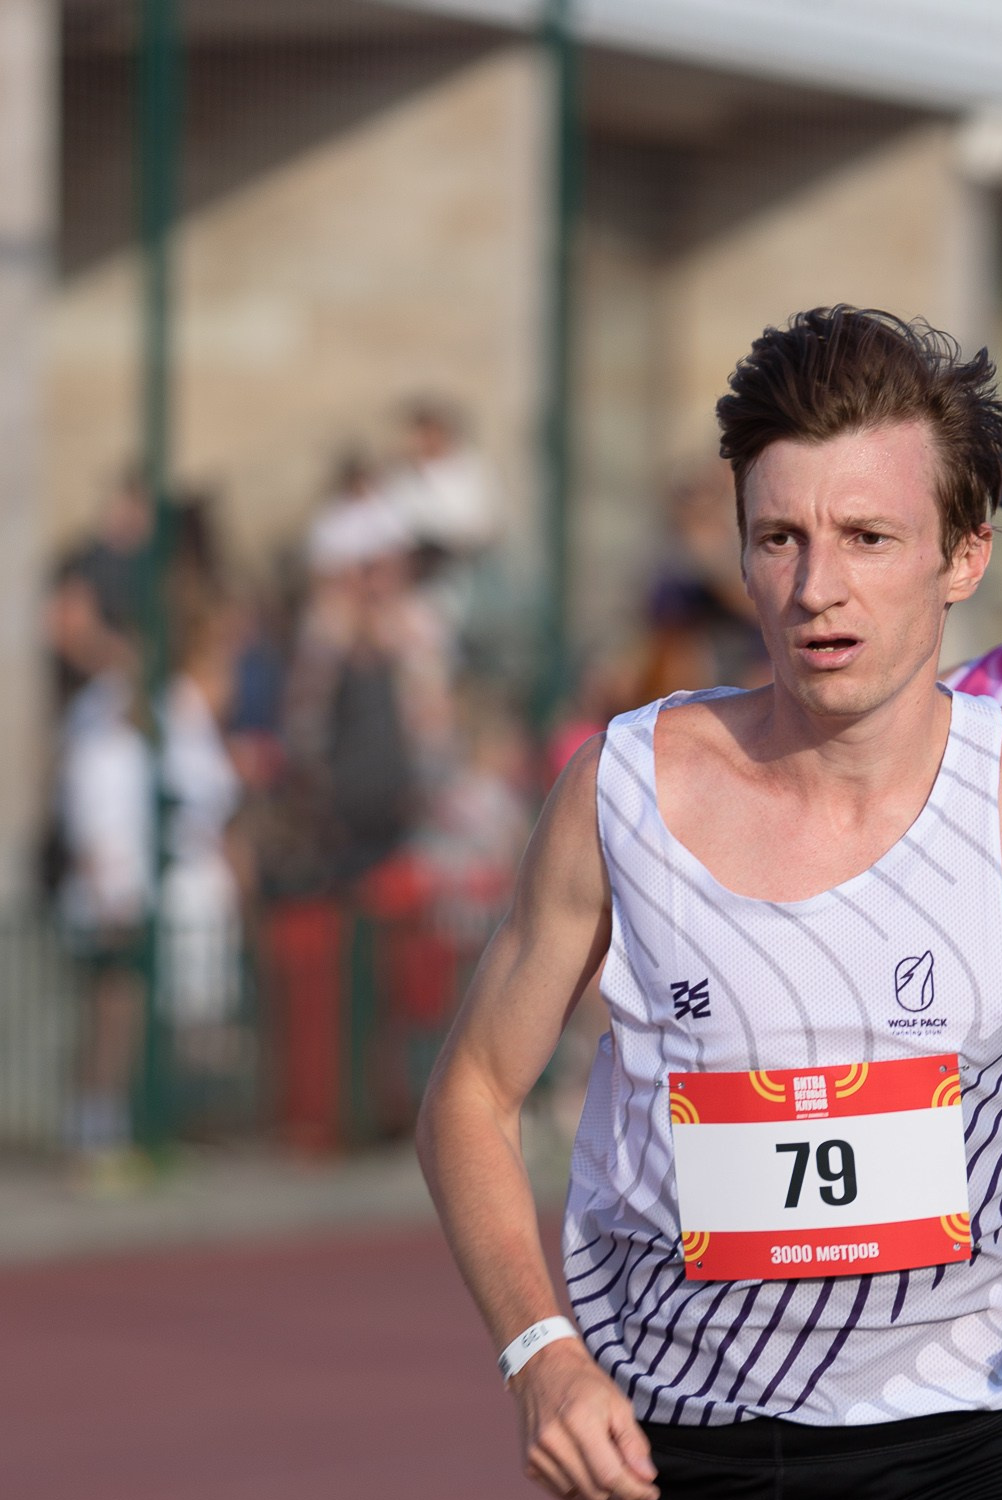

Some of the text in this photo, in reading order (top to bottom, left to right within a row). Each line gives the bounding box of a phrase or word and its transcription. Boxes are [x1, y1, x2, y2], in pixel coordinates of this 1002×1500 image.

[888, 1018, 947, 1028] WOLF PACK
[793, 1075, 826, 1091] БИТВА
[795, 1098, 829, 1112] КЛУБОВ
[775, 1139, 858, 1209] 79
[770, 1242, 880, 1264] 3000 метров
